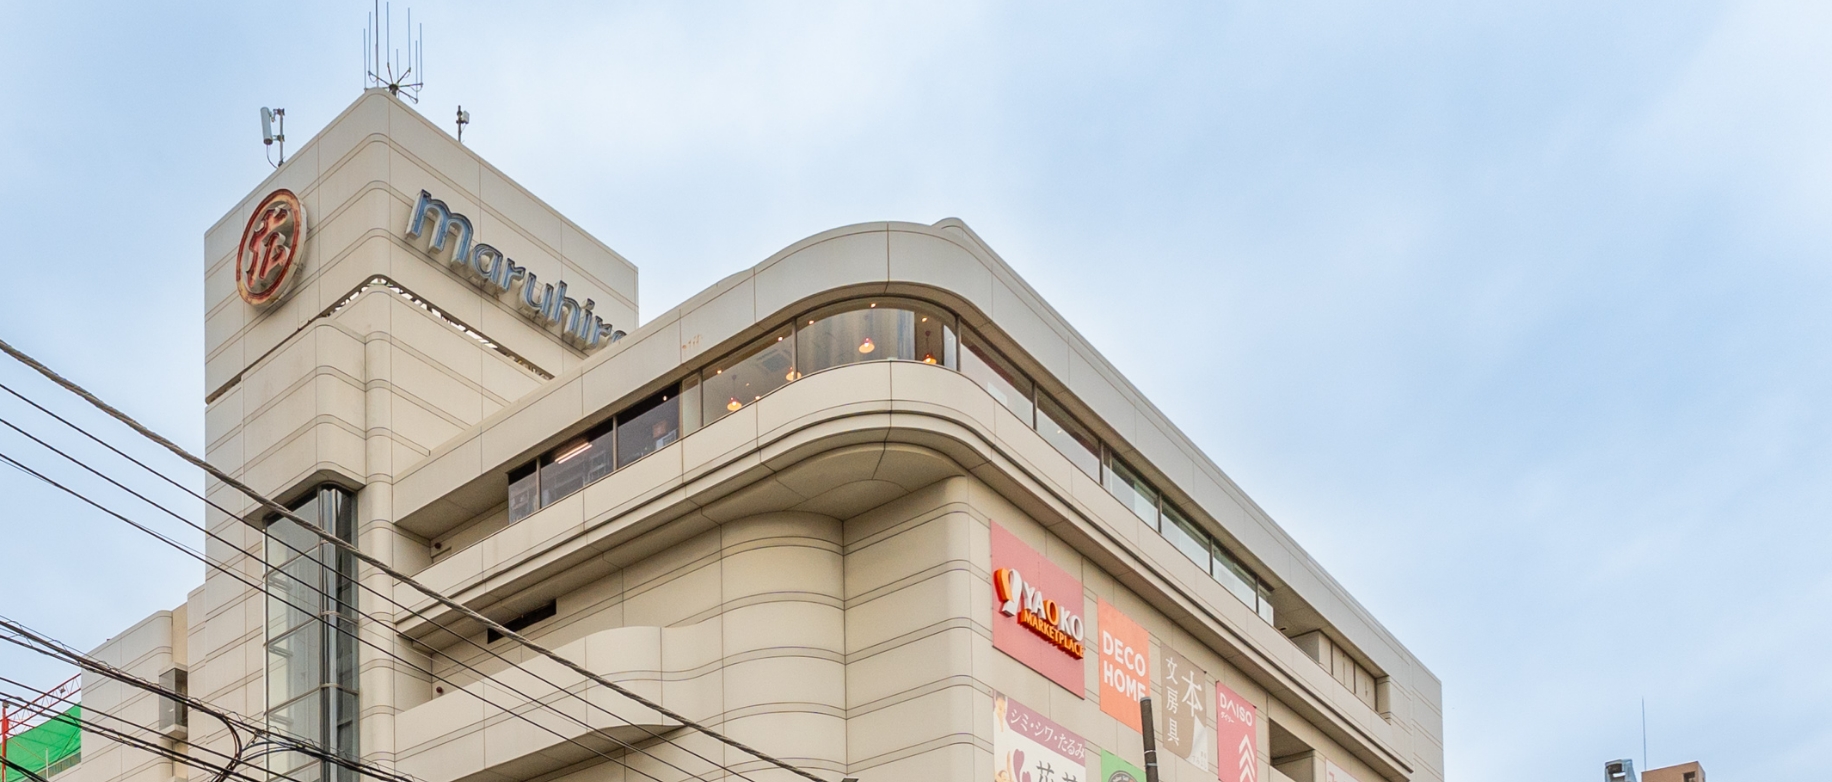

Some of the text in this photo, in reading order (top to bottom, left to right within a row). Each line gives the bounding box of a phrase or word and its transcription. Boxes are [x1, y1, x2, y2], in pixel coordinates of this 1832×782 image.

[1021, 608, 1084, 659] MARKETPLACE
[1022, 581, 1084, 642] YAOKO
[1102, 629, 1146, 677] DECO
[1165, 656, 1180, 747] 文房具
[1181, 670, 1204, 717] 本
[1219, 692, 1253, 727] DAISO
[1010, 708, 1085, 760] シミ・シワ・たるみ
